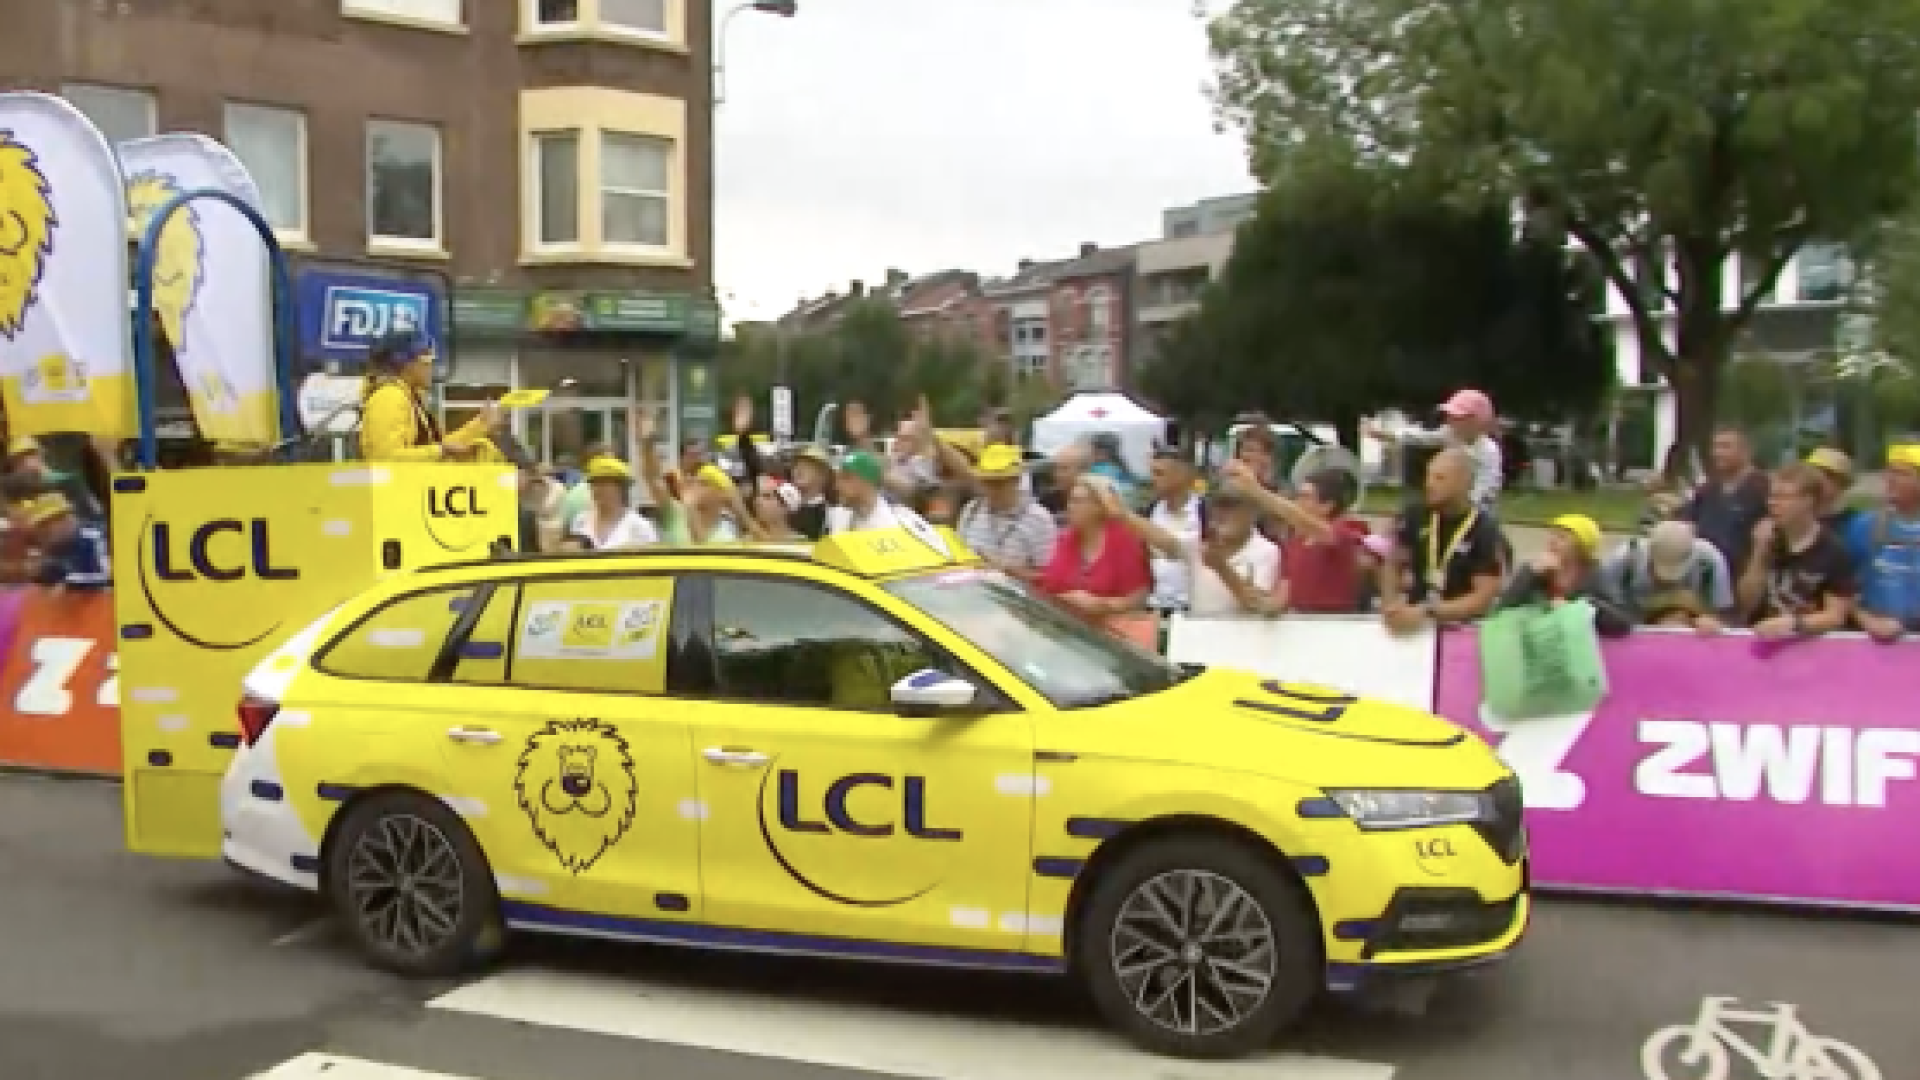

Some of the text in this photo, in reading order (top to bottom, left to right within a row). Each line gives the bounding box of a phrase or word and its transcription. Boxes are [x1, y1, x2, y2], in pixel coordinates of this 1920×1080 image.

[334, 299, 389, 338] FDJ
[427, 485, 488, 517] LCL
[152, 518, 300, 582] LCL
[576, 613, 608, 629] LCL
[1633, 720, 1920, 807] ZWIF
[777, 770, 963, 841] LCL
[1414, 838, 1457, 857] LCL
